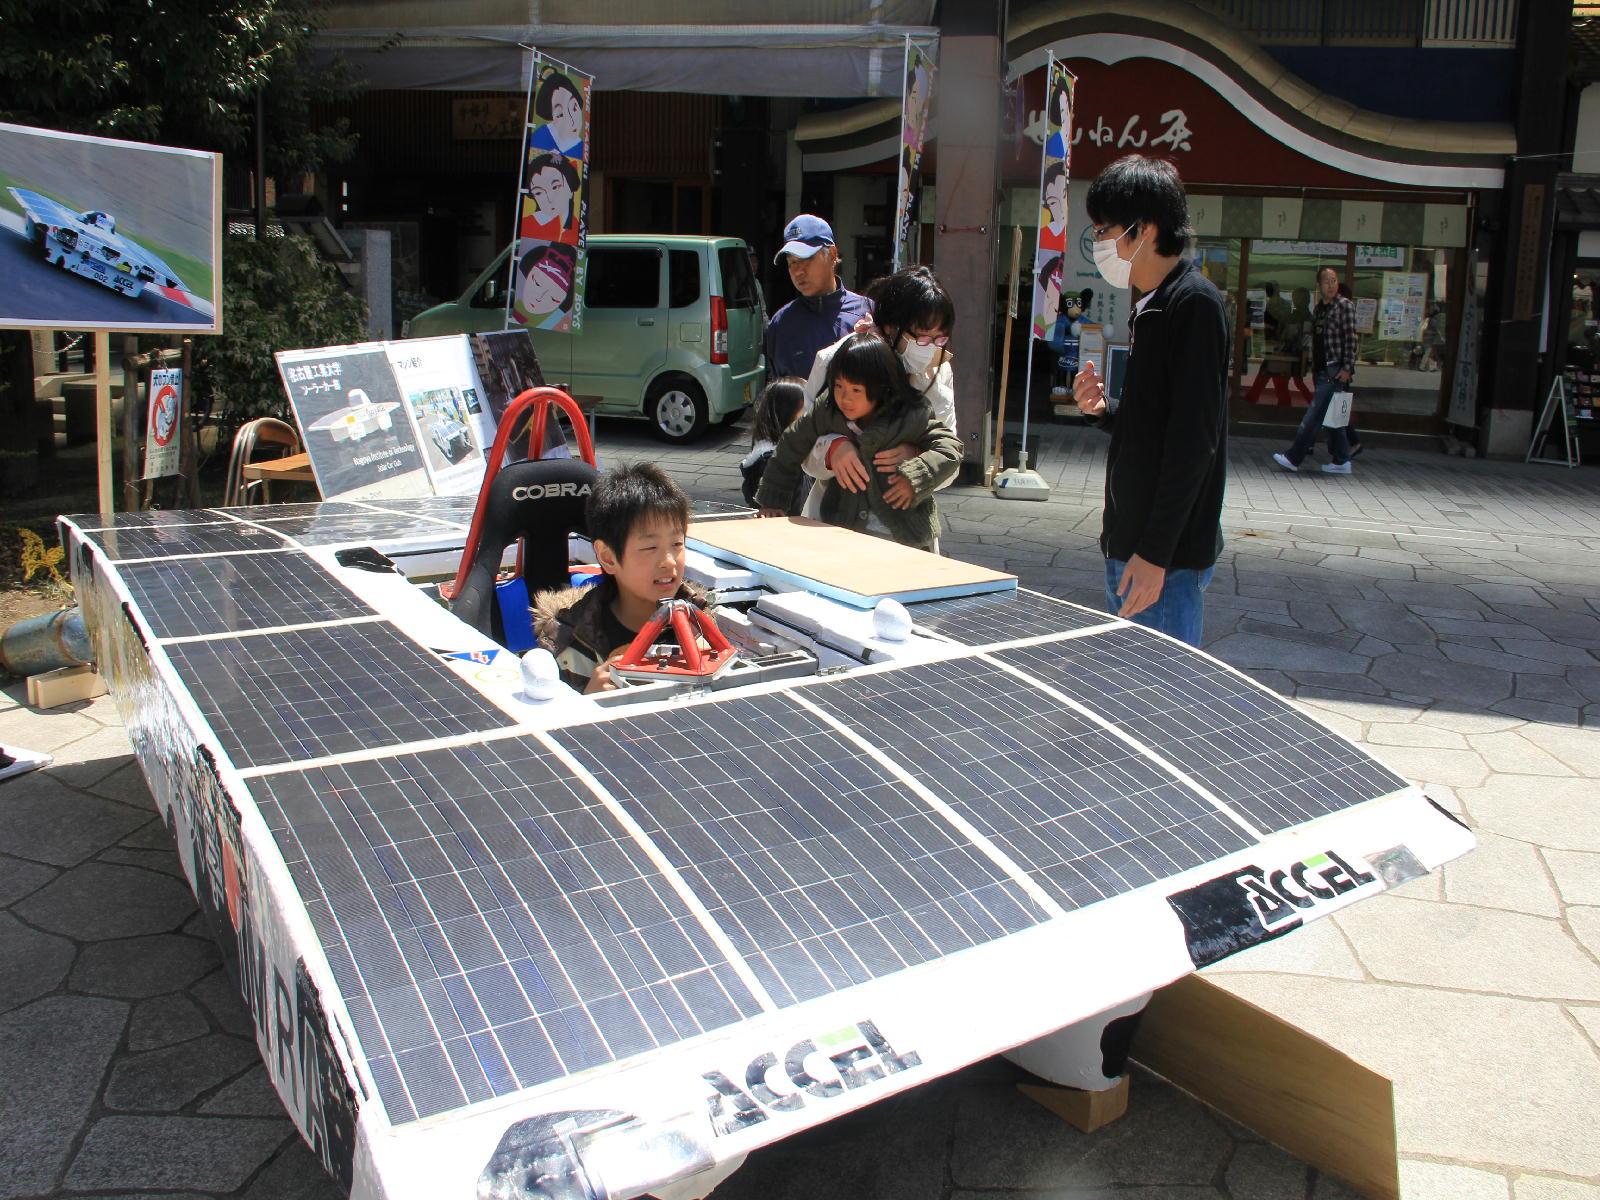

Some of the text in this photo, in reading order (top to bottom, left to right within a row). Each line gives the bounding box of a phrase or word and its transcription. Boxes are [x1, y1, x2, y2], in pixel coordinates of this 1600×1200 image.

[571, 84, 592, 330] THE KABUKI PLAYED BY BOYS
[512, 482, 592, 501] COBRA
[1243, 850, 1376, 926] ACCEL
[699, 1018, 923, 1138] ACCEL
